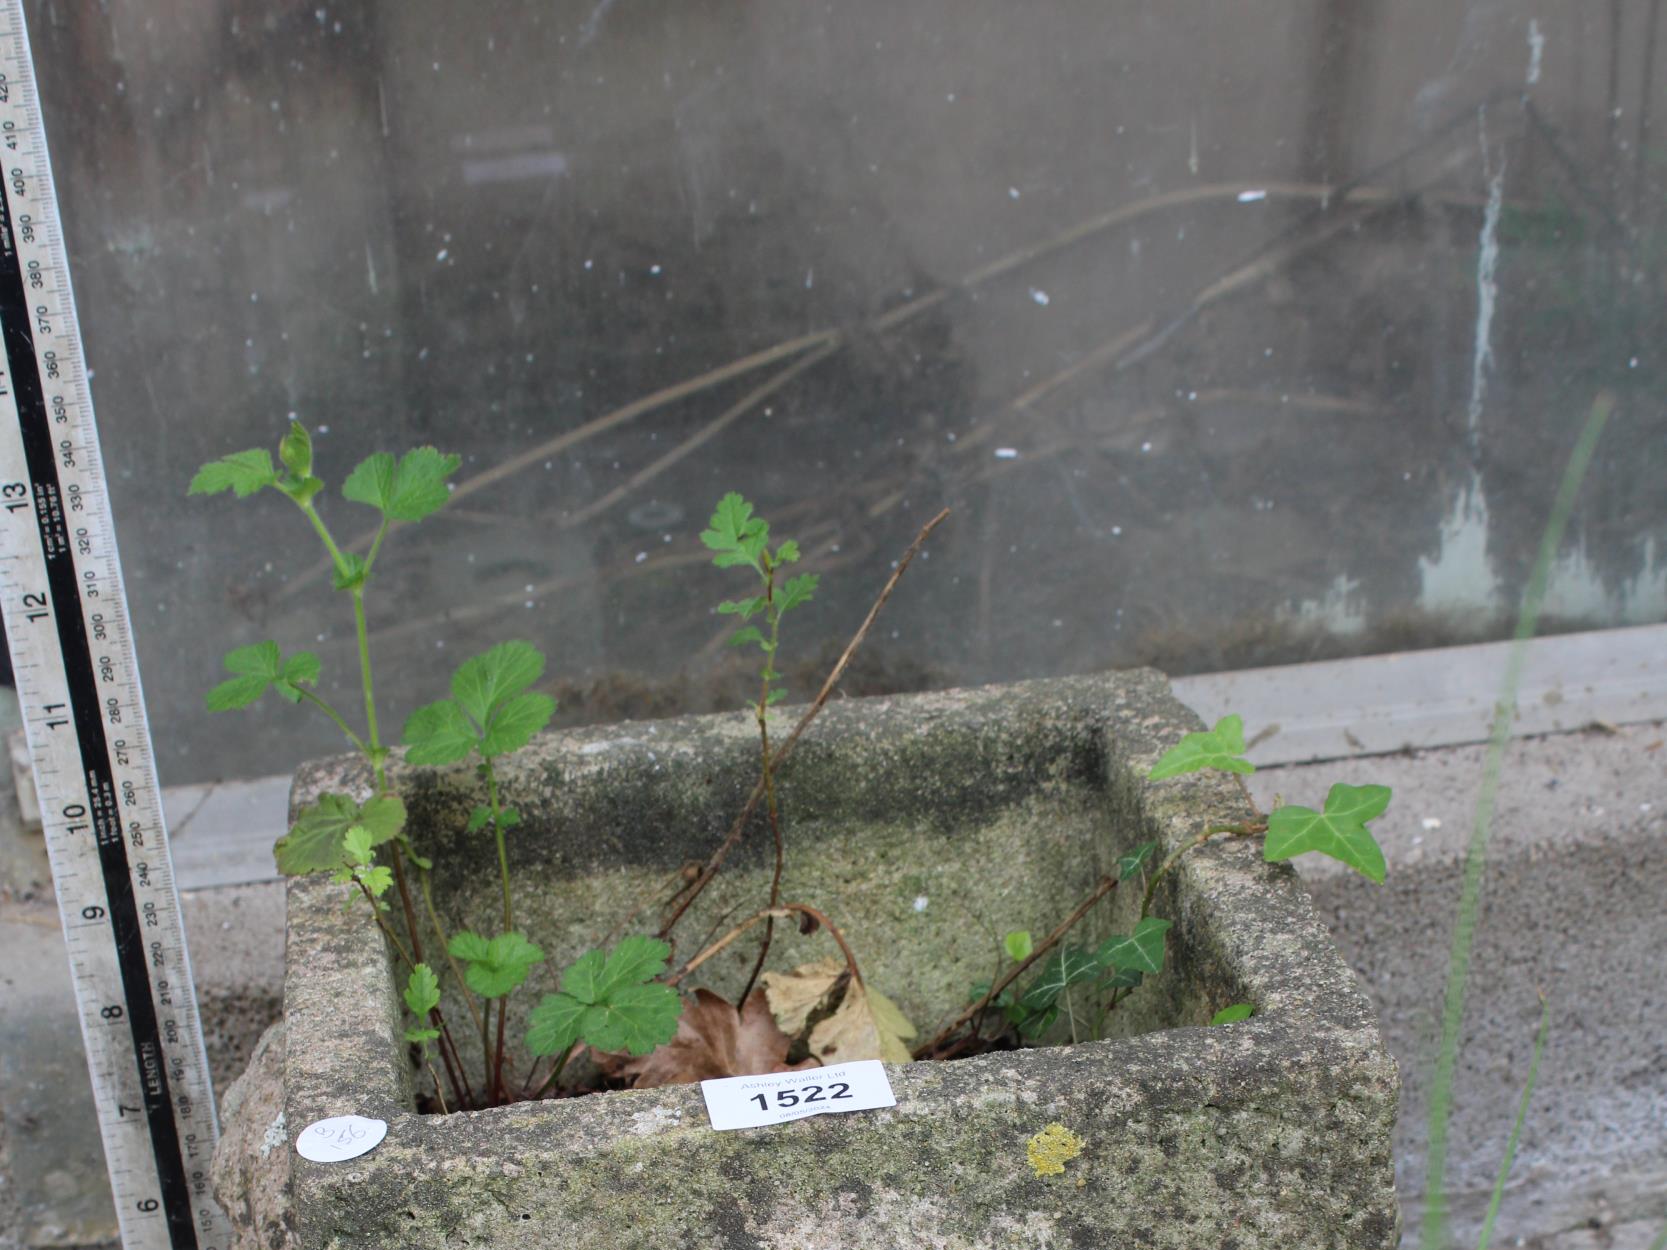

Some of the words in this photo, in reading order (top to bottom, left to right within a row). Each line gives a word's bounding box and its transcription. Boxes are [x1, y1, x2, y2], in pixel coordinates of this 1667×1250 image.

[3, 121, 17, 150] 410
[11, 168, 25, 197] 400
[19, 214, 35, 244] 390
[28, 260, 43, 289] 380
[37, 306, 53, 334] 370
[46, 351, 60, 379] 360
[53, 395, 68, 424] 350
[61, 440, 76, 468] 340
[3, 481, 29, 513] 13
[70, 484, 84, 512] 330
[77, 527, 92, 556] 320
[85, 571, 100, 598] 310
[24, 592, 50, 622] 12
[92, 614, 107, 640] 300
[100, 656, 115, 683] 290
[43, 703, 69, 731] 11
[107, 698, 122, 724] 280
[115, 739, 130, 766] 270
[122, 780, 137, 808] 260
[62, 804, 89, 834] 10
[129, 821, 144, 848] 250
[137, 862, 149, 888] 240
[82, 905, 105, 920] 9
[146, 902, 158, 927] 230
[153, 942, 166, 967] 220
[160, 981, 172, 1006] 210
[101, 1004, 124, 1020] 8
[166, 1019, 179, 1044] 200
[140, 1042, 162, 1095] LENGTH
[741, 1082, 781, 1090] Ashley
[750, 1083, 853, 1111] 1522
[119, 1104, 141, 1117] 7
[181, 1096, 192, 1120] 180
[188, 1134, 198, 1159] 170
[194, 1172, 206, 1197] 160
[137, 1198, 159, 1213] 6
